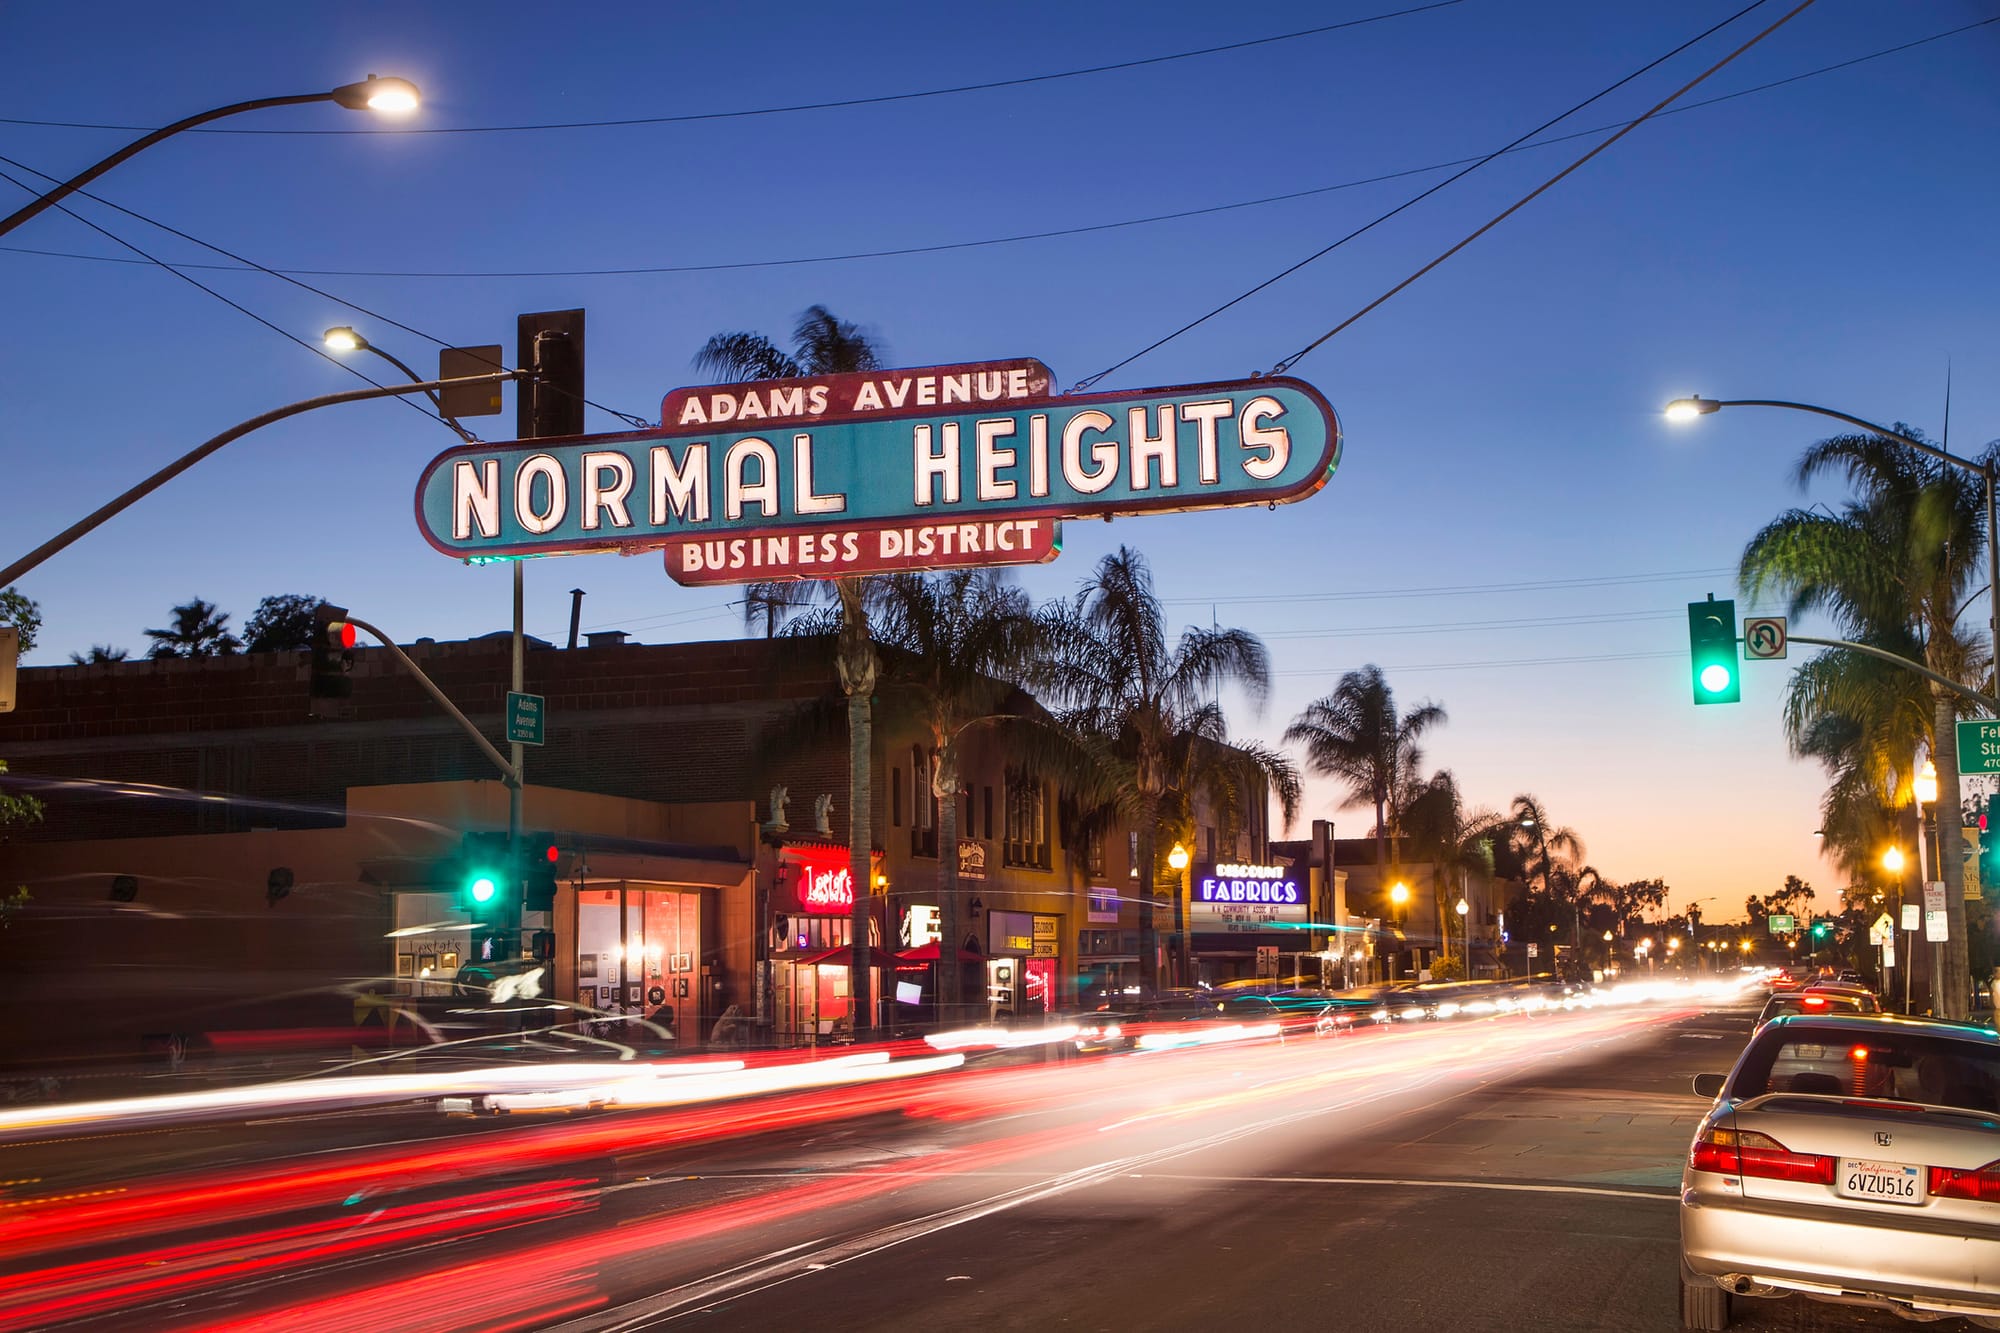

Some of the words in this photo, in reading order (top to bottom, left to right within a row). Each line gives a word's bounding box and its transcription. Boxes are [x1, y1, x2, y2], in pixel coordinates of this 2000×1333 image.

[679, 385, 829, 425] ADAMS
[852, 368, 1029, 411] AVENUE
[451, 432, 848, 541] NORMAL
[913, 396, 1291, 507] HEIGHTS
[682, 532, 860, 573] BUSINESS
[879, 520, 1039, 559] DISTRICT
[517, 698, 537, 712] Adams
[515, 713, 537, 727] Avenue
[1216, 864, 1284, 878] DISCOUNT
[1203, 879, 1297, 902] FABRICS
[1859, 1163, 1906, 1176] California
[1848, 1173, 1915, 1197] 6VZU516
